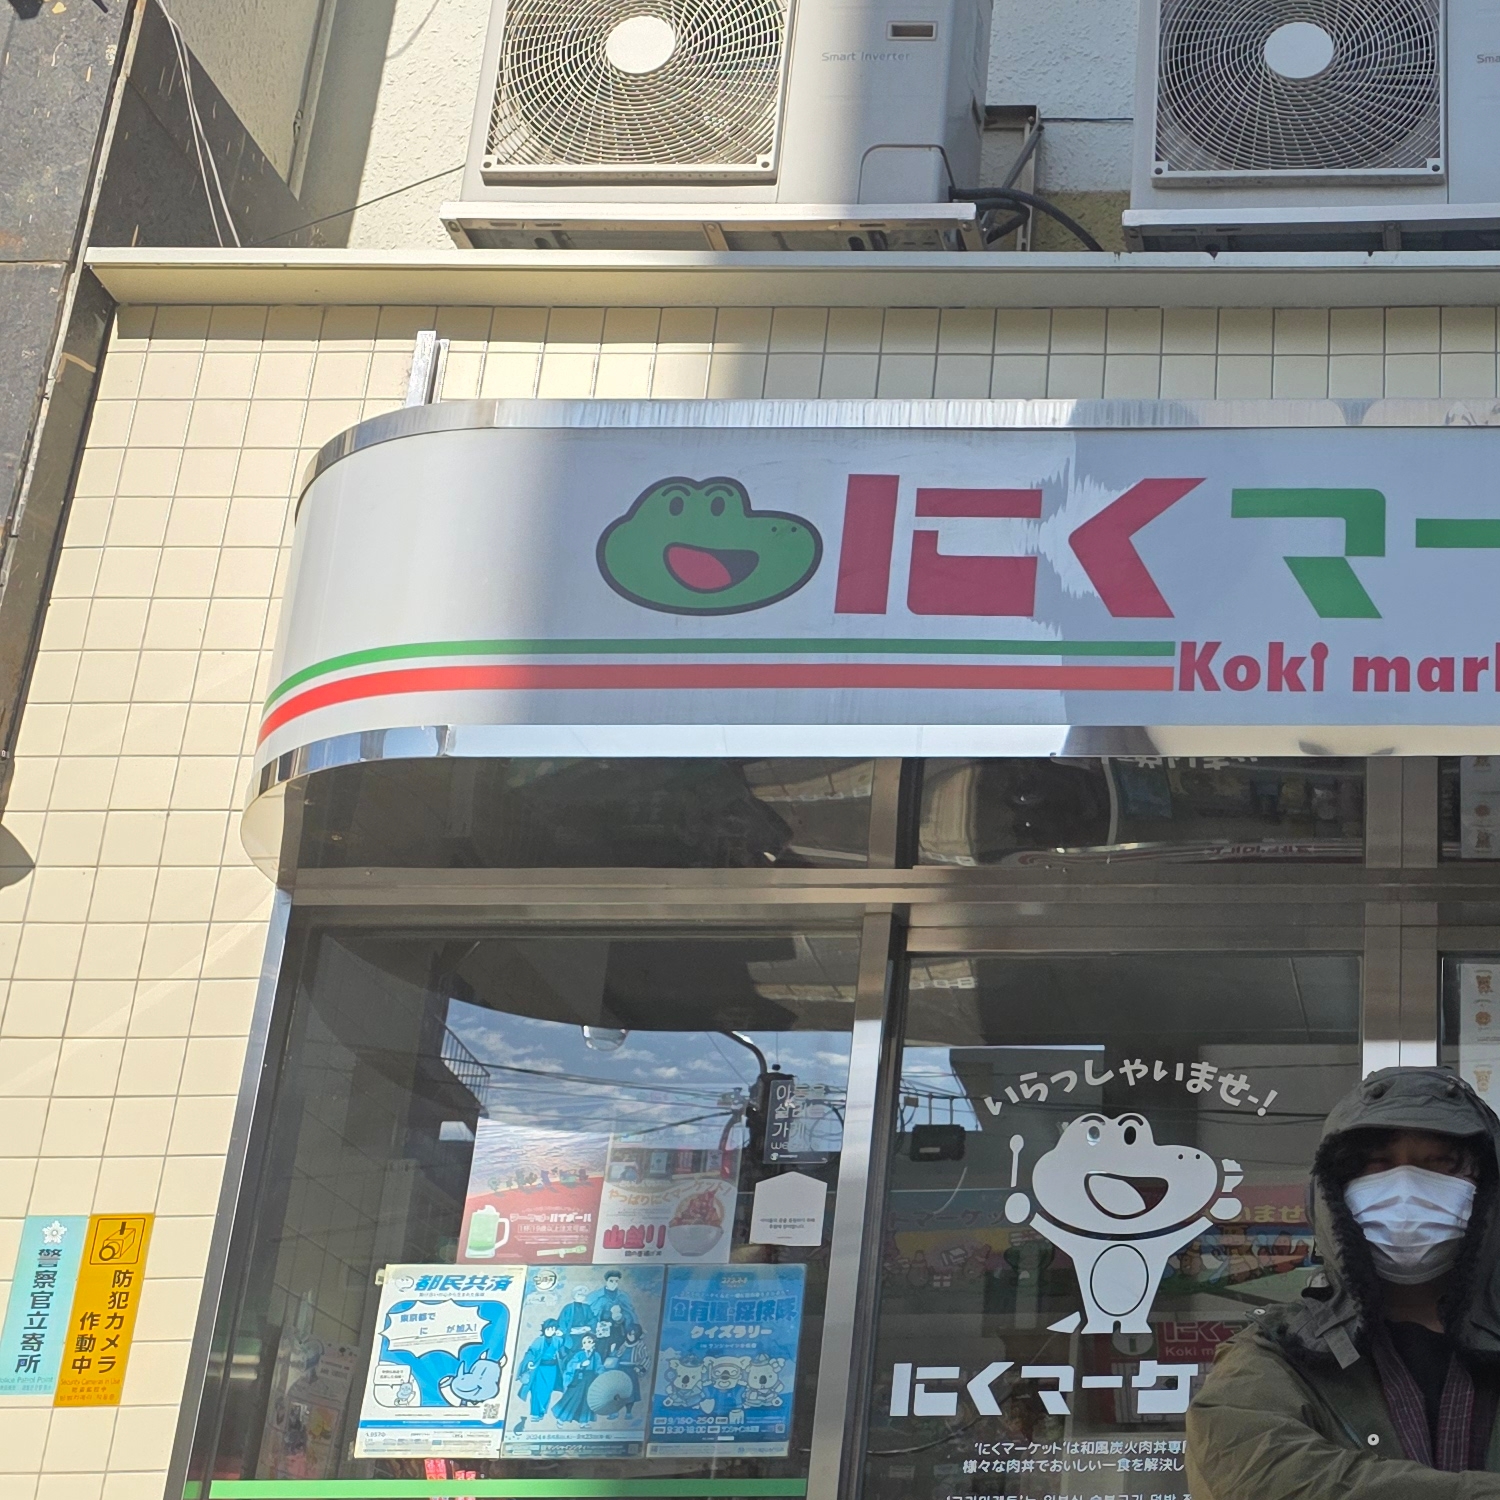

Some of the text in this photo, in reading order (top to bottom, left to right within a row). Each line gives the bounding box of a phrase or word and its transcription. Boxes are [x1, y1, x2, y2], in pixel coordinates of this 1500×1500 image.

[821, 51, 911, 62] Smart Inverter
[1177, 640, 1329, 694] Koki
[414, 1274, 514, 1292] 都民共済
[14, 1247, 64, 1375] 警察官立寄所
[97, 1269, 135, 1374] 防犯カメラ
[400, 1312, 436, 1323] 東京都で
[71, 1311, 102, 1375] 作動中
[690, 1324, 773, 1340] クイズラリー
